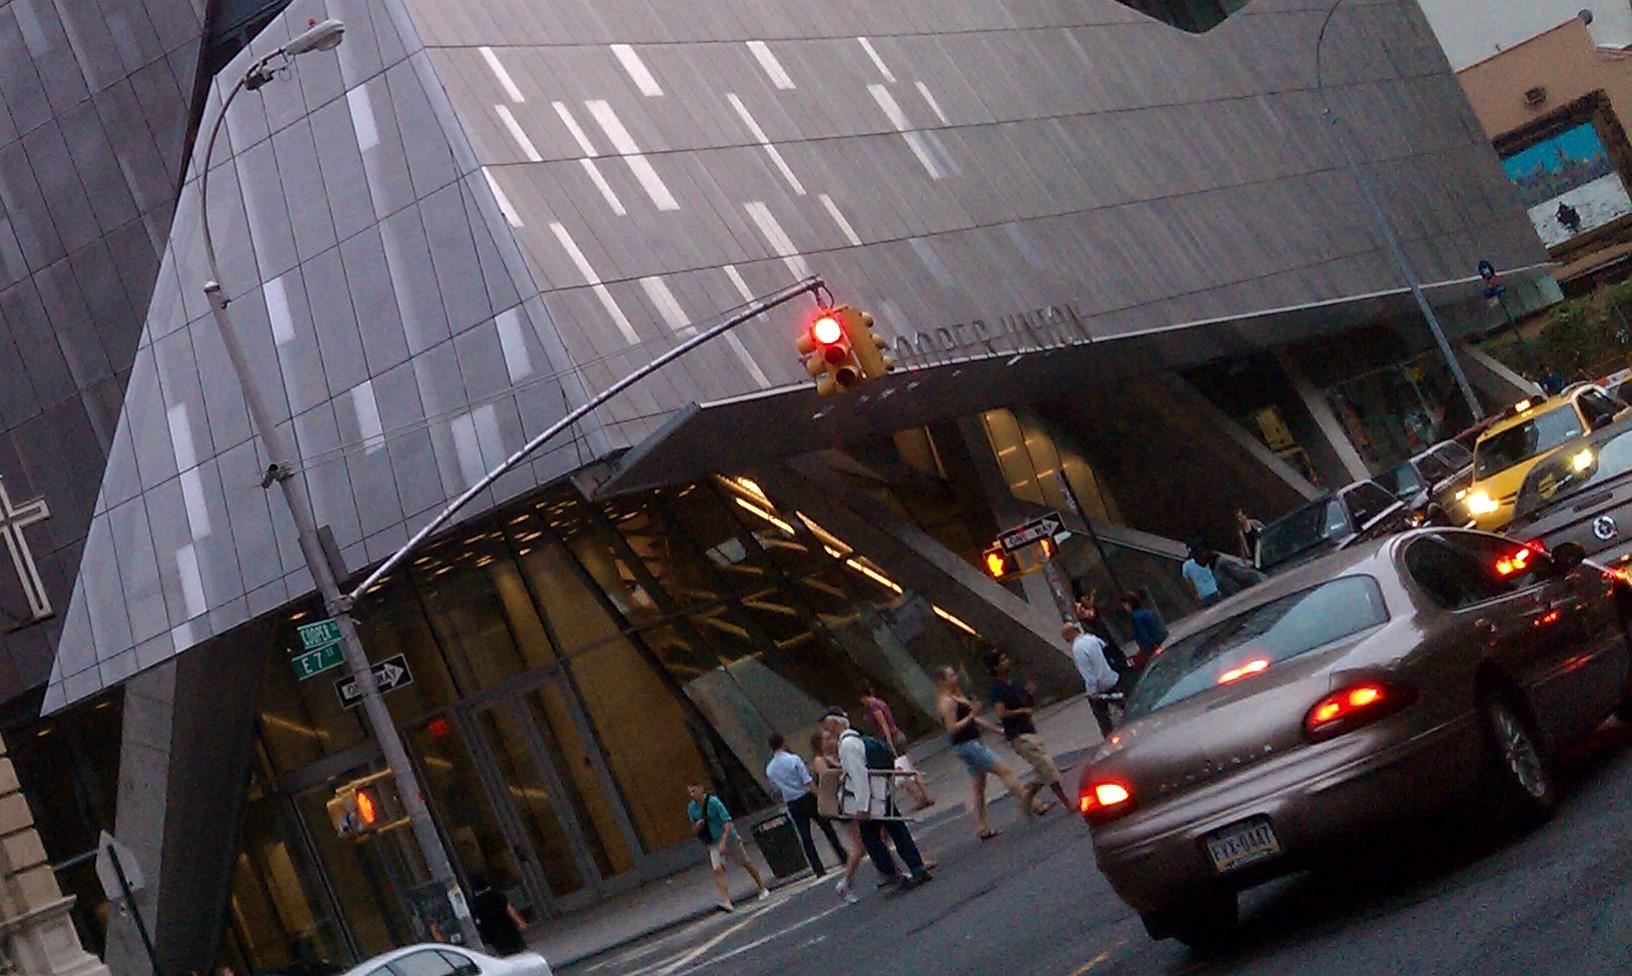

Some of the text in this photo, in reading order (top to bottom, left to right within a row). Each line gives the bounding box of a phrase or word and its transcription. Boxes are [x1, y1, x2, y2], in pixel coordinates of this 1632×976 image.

[893, 319, 999, 370] OOPER
[300, 625, 331, 645] COOPER
[301, 658, 313, 674] E
[313, 652, 323, 668] 7
